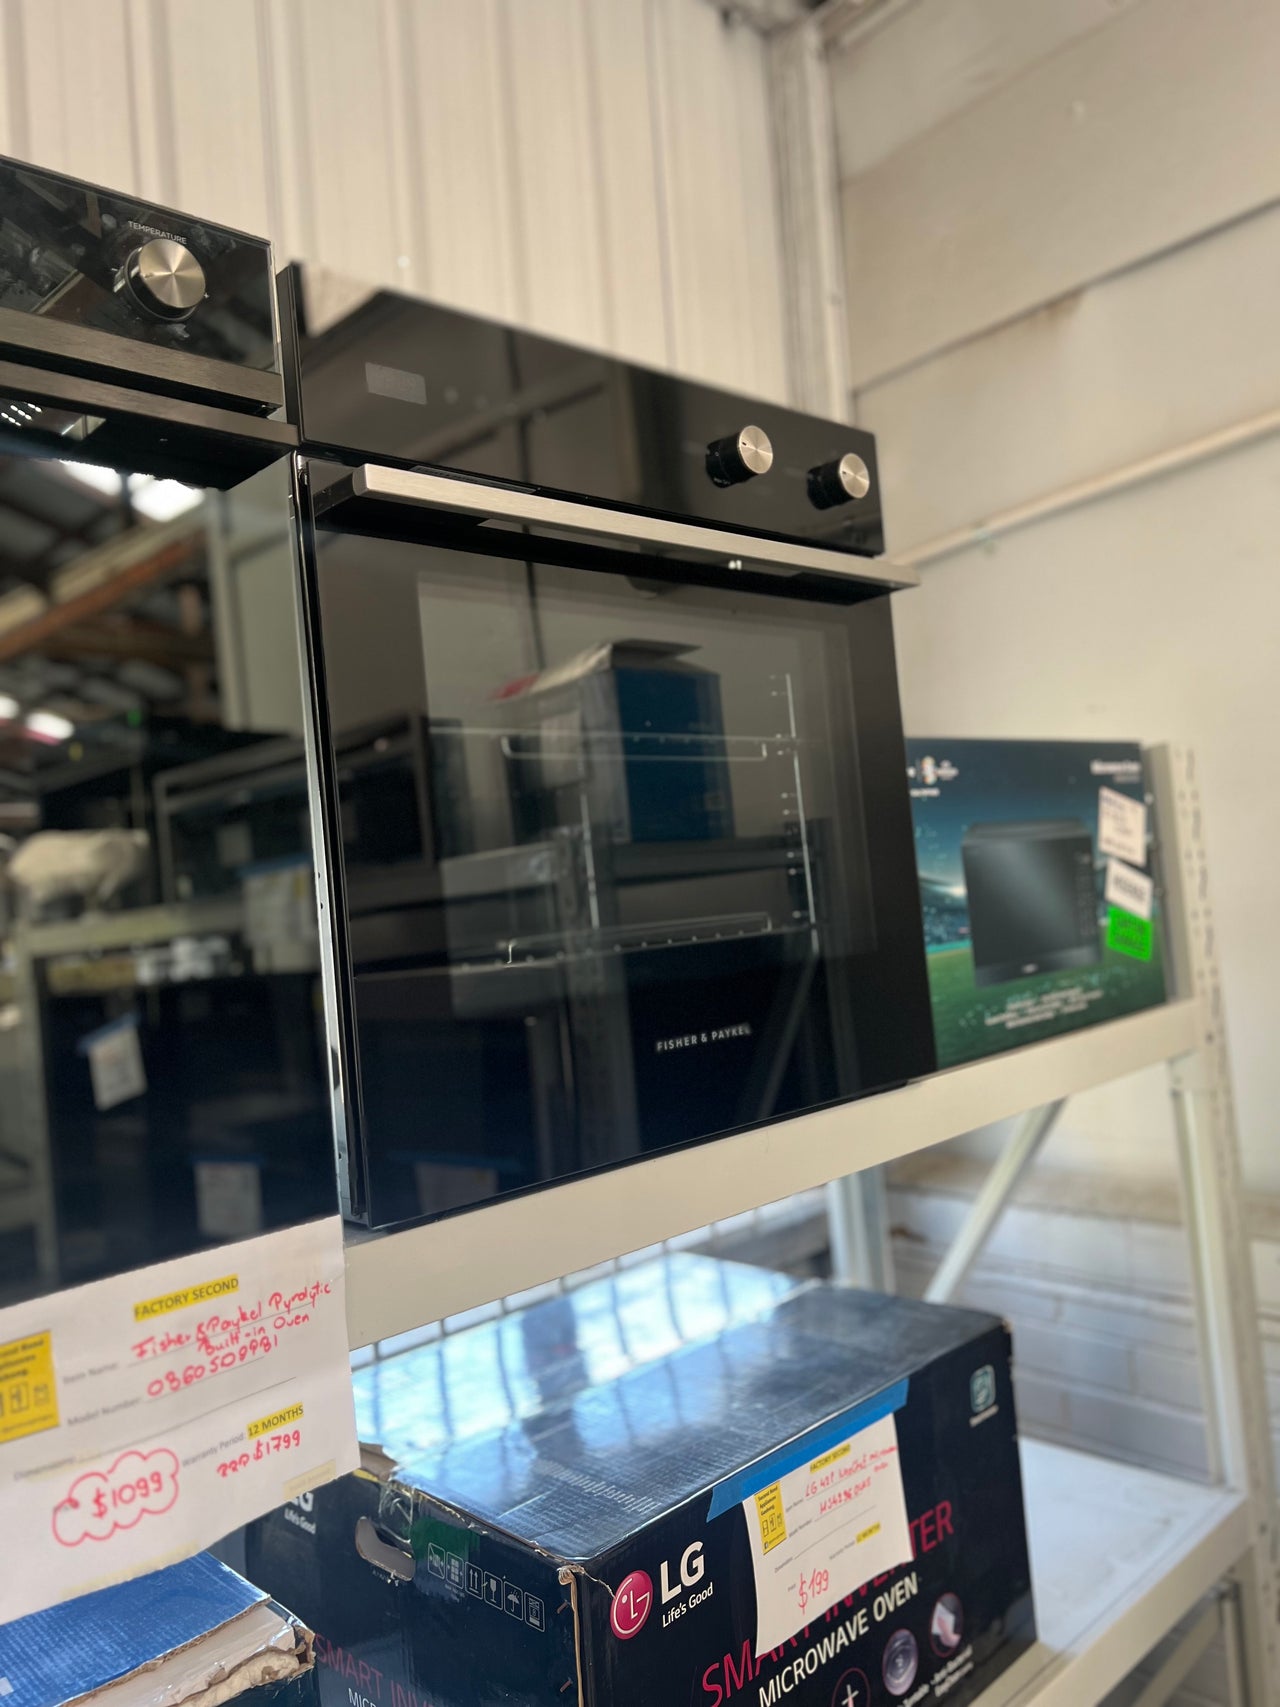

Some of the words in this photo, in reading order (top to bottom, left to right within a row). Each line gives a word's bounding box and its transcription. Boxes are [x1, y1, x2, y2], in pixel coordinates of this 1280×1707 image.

[127, 220, 188, 245] TEMPERATURE
[656, 1034, 698, 1052] FISHER
[701, 1033, 708, 1043] &
[711, 1022, 751, 1040] PAYKEL
[134, 1292, 189, 1319] FACTORY
[192, 1278, 239, 1300] SECOND
[273, 1312, 310, 1331] Oven
[247, 1424, 259, 1437] 12
[261, 1405, 304, 1431] MONTHS
[253, 1430, 301, 1461] $1799
[92, 1471, 163, 1519] $1099
[805, 1481, 818, 1498] LG
[660, 1541, 705, 1604] LG
[798, 1567, 829, 1616] $199
[662, 1602, 687, 1628] Life's
[688, 1581, 714, 1608] Good
[758, 1609, 870, 1707] MICROWAVE
[872, 1571, 918, 1622] OVEN
[315, 1632, 383, 1699] SMART
